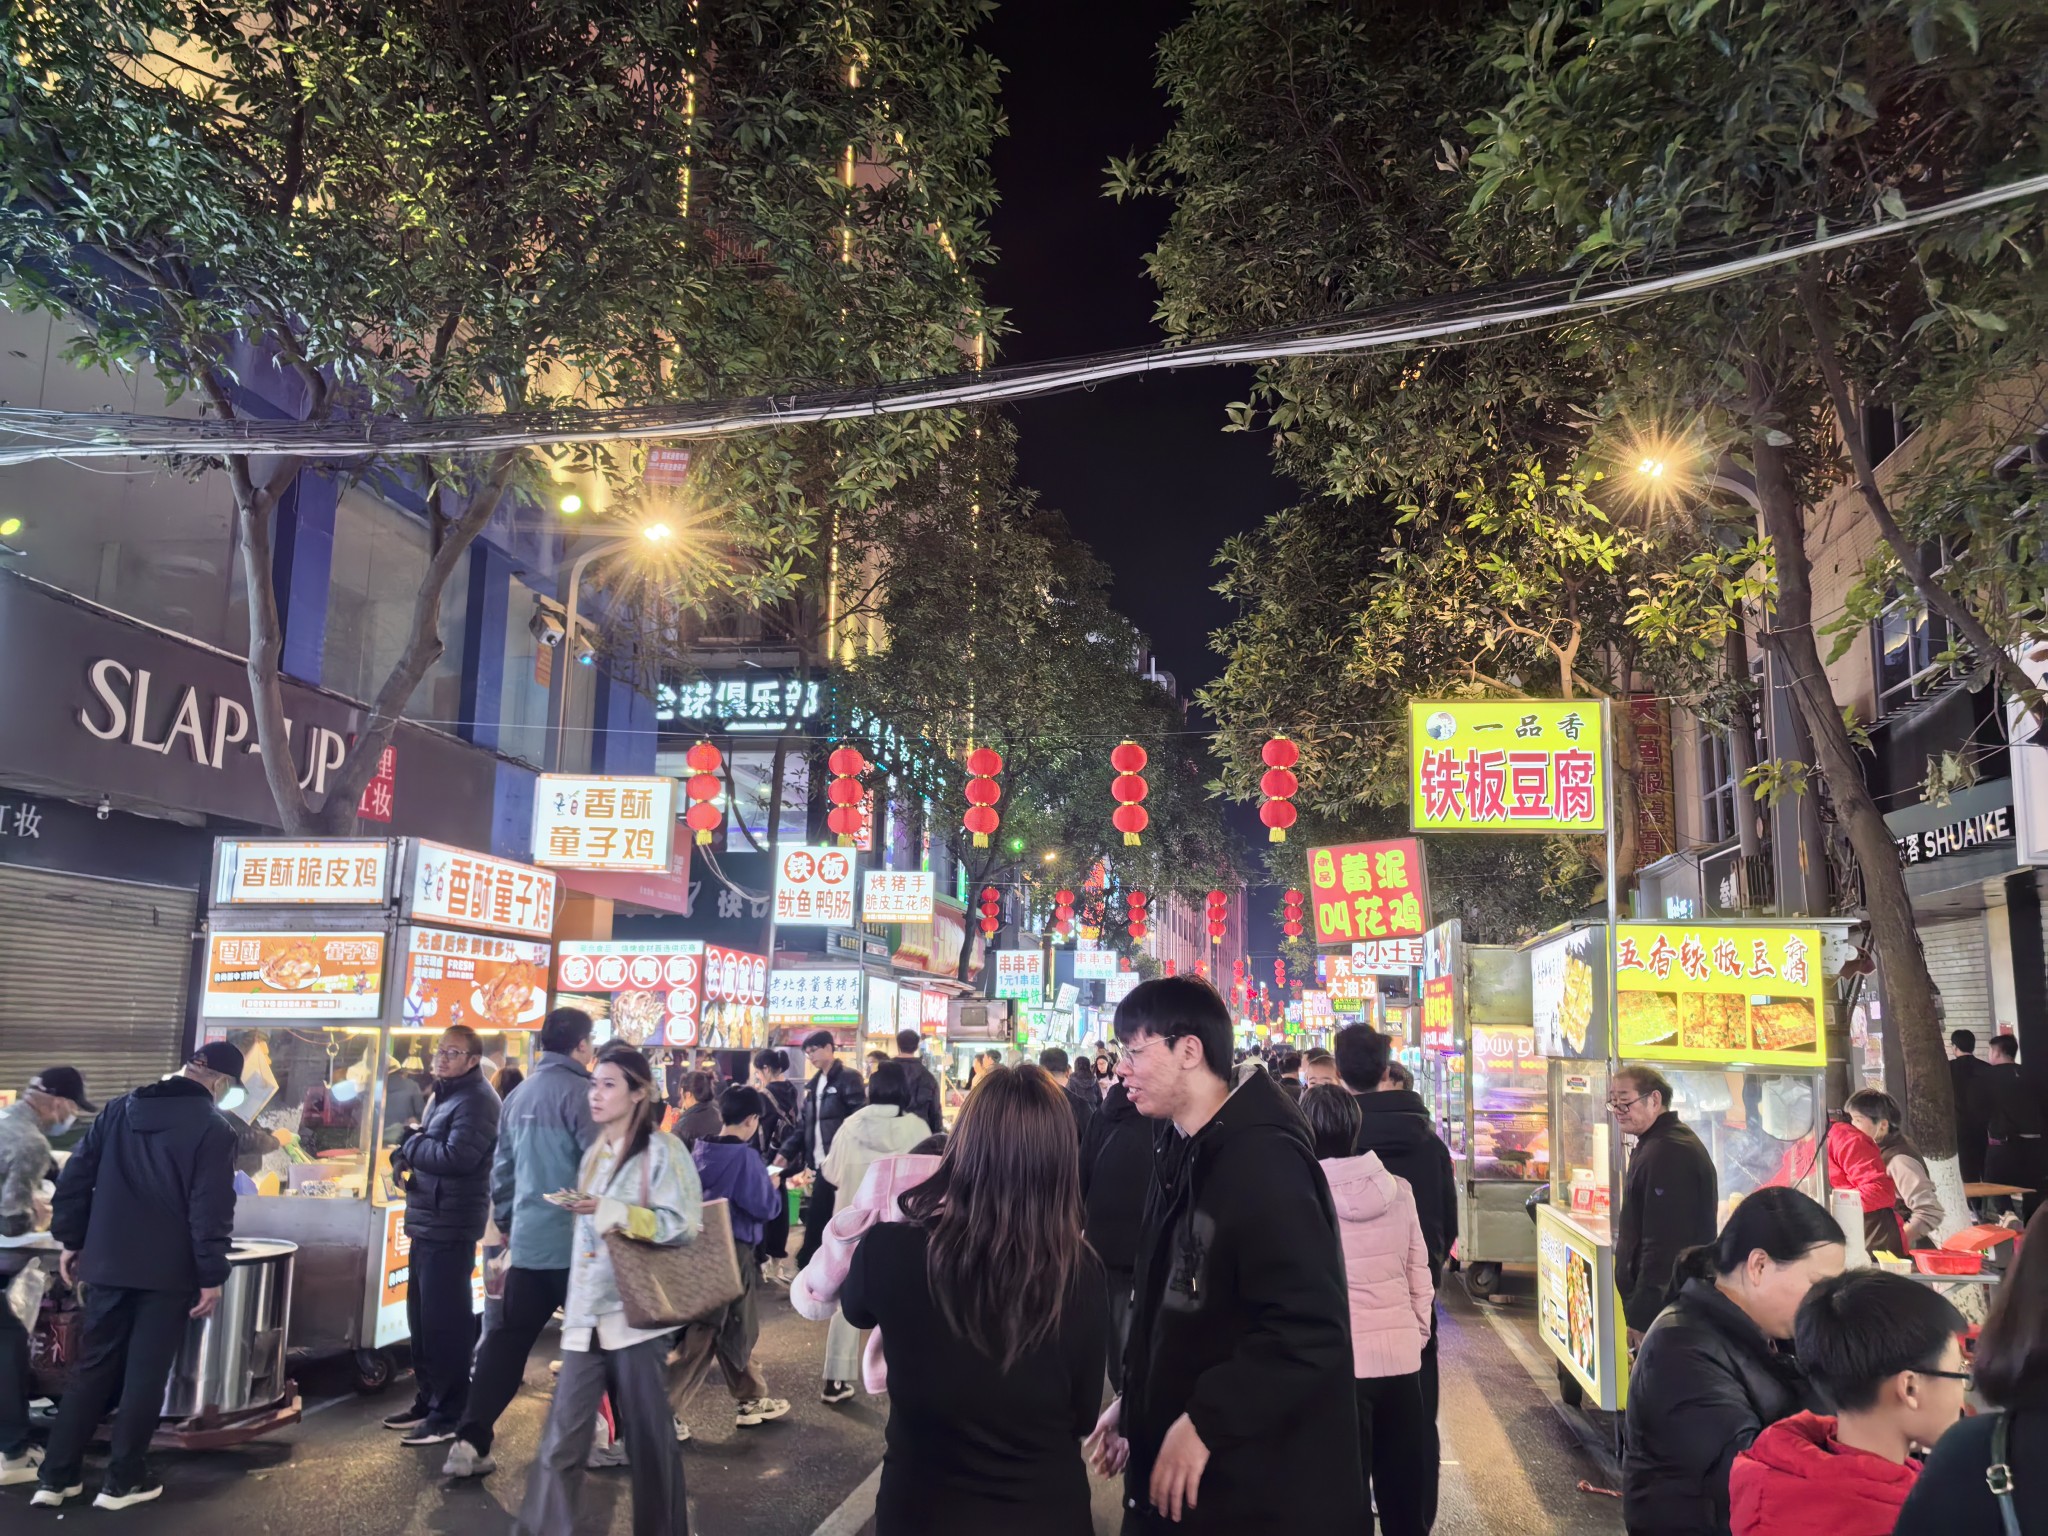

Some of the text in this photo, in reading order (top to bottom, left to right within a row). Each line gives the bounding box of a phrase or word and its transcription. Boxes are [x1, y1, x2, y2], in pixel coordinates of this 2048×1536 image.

[1473, 712, 1585, 741] 一品香
[1420, 746, 1596, 823] 铁板豆腐
[584, 788, 653, 820] 香酥
[549, 826, 655, 860] 童子鸡
[1924, 806, 2010, 858] SHUAIKE
[242, 857, 377, 887] 香酥脆皮鸡
[788, 854, 845, 882] 铁板
[1341, 849, 1409, 894] 黄泥
[447, 858, 552, 929] 香酥童子鸡
[870, 875, 926, 893] 烤猪手
[865, 895, 931, 911] 脆皮五花肉
[1320, 891, 1422, 938] 叫花鸡
[219, 940, 379, 962] 香酥 童子鸡
[999, 954, 1040, 974] 串串香
[1076, 952, 1113, 965] 串串香
[1367, 940, 1424, 964] 小土豆
[1616, 933, 1809, 986] 五香铁板豆腐
[448, 959, 475, 972] FRESH
[769, 975, 860, 993] 老北京酱香猪手
[999, 974, 1040, 987] 1元1串起
[1327, 977, 1377, 999] 大油边
[769, 995, 860, 1011] 网红脆皮五花肉
